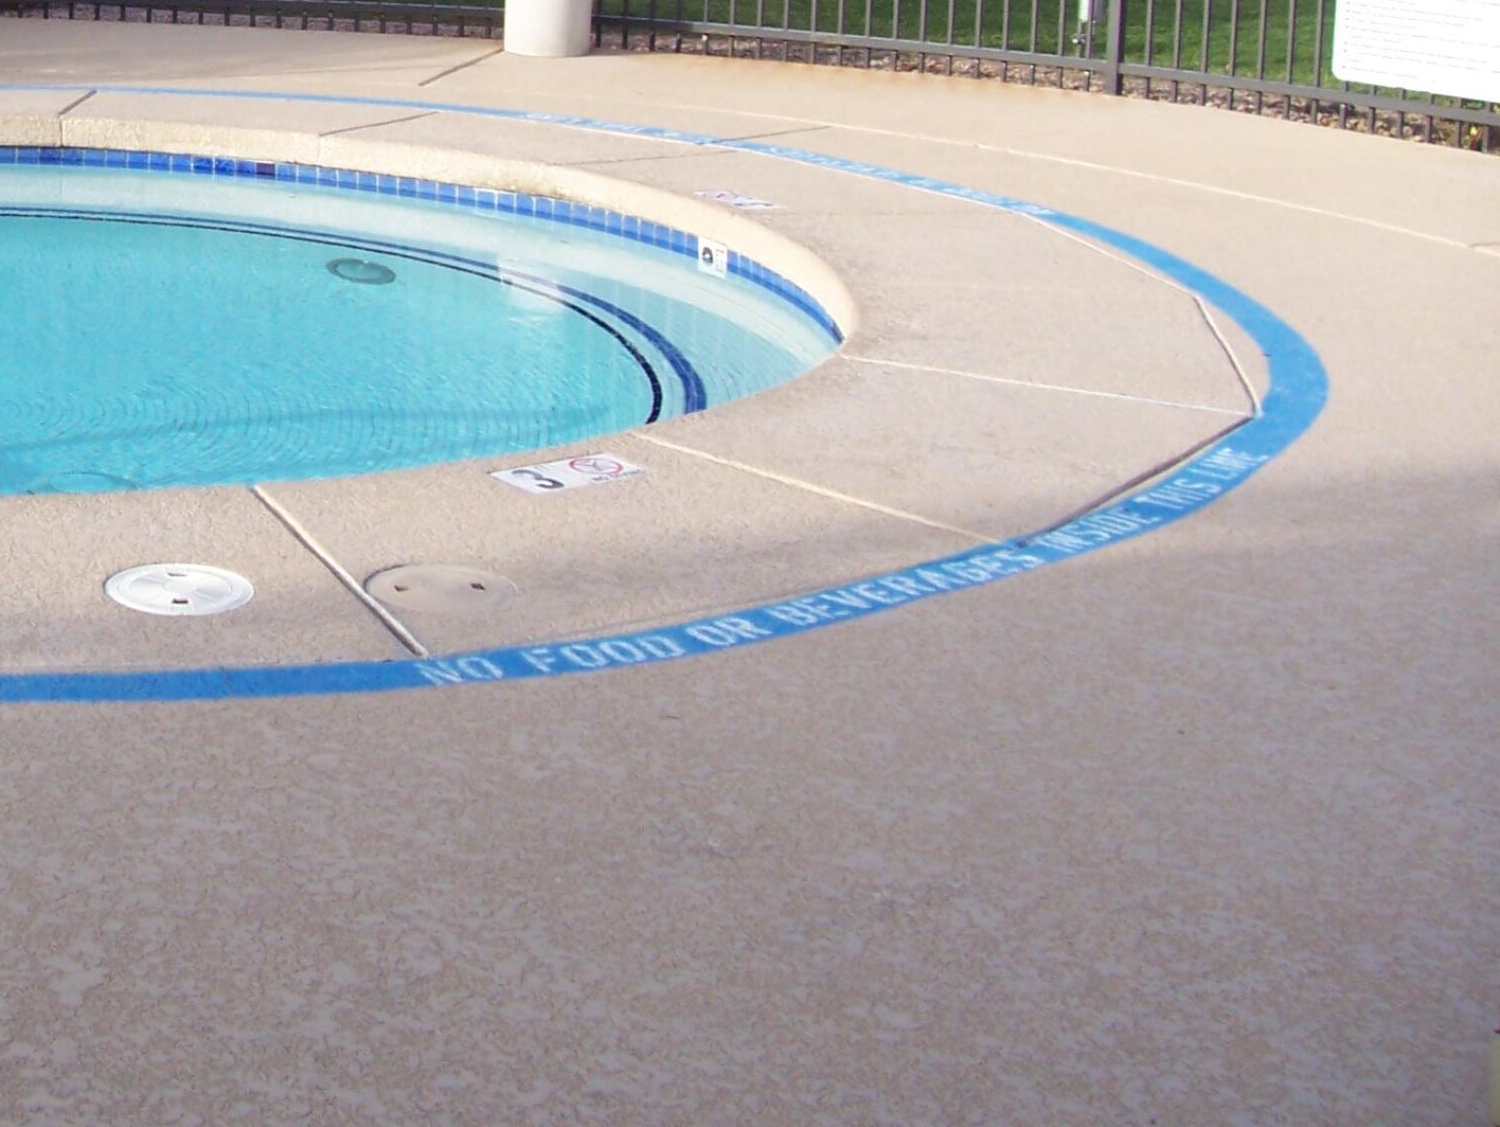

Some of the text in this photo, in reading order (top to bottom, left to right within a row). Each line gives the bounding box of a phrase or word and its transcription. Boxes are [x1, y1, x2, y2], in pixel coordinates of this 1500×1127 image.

[414, 656, 503, 685] NO
[520, 634, 686, 673] FOOD
[686, 616, 773, 647] OR
[765, 547, 1046, 626] BEVERAGES
[1032, 507, 1163, 554] INSIDE
[1132, 478, 1222, 510] THIS
